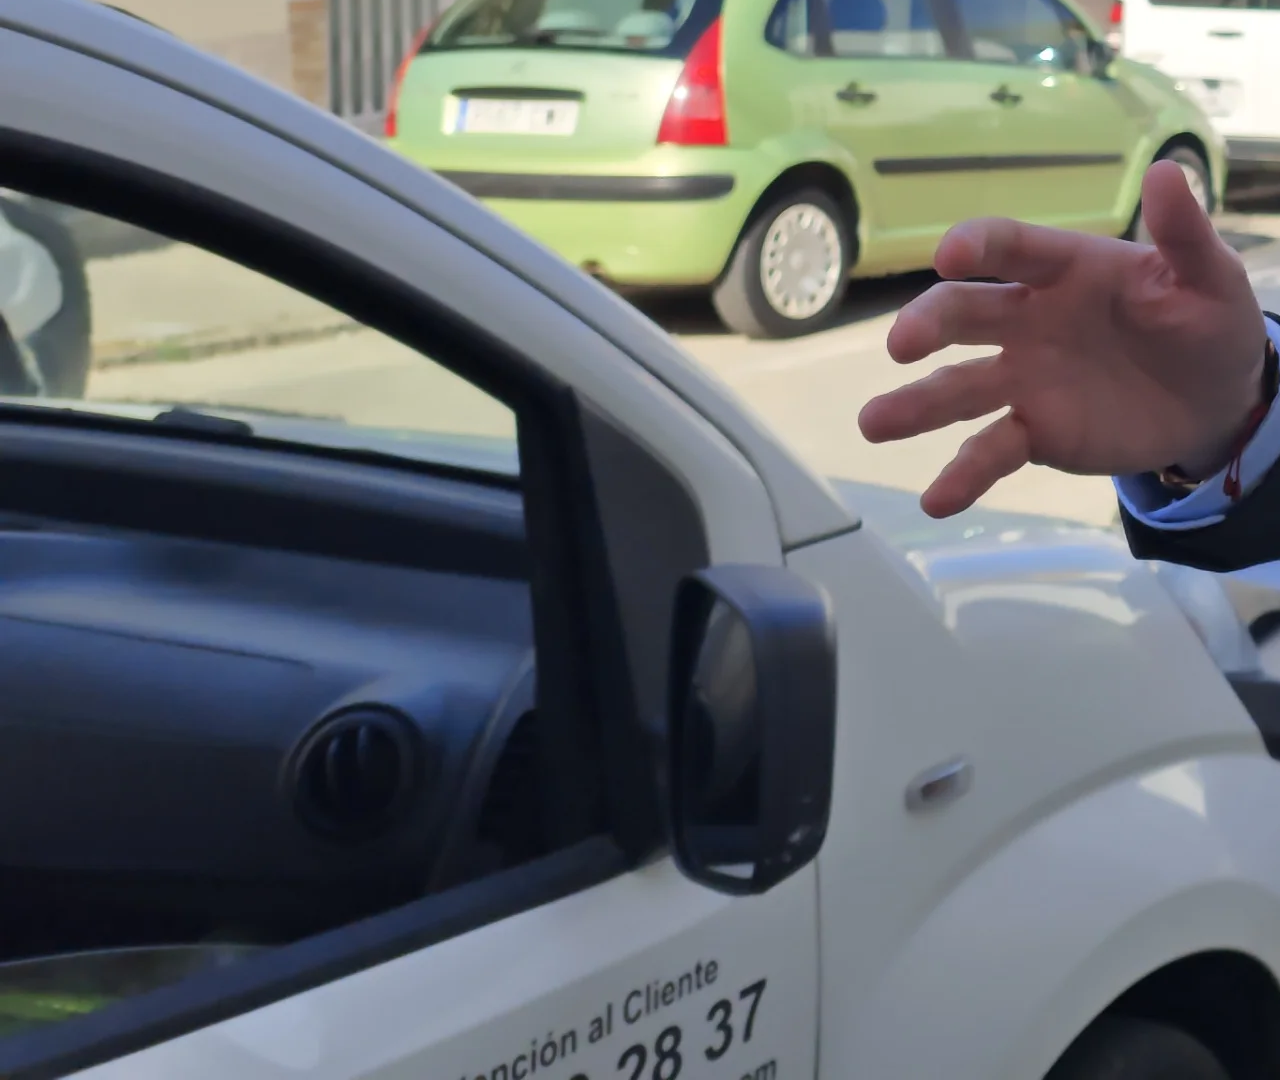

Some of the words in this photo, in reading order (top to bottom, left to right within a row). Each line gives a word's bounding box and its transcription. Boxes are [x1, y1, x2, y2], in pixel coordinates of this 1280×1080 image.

[459, 1026, 578, 1080] nción
[587, 1002, 613, 1045] al
[622, 958, 719, 1026] Cliente
[616, 1024, 683, 1080] 28
[704, 977, 768, 1062] 37
